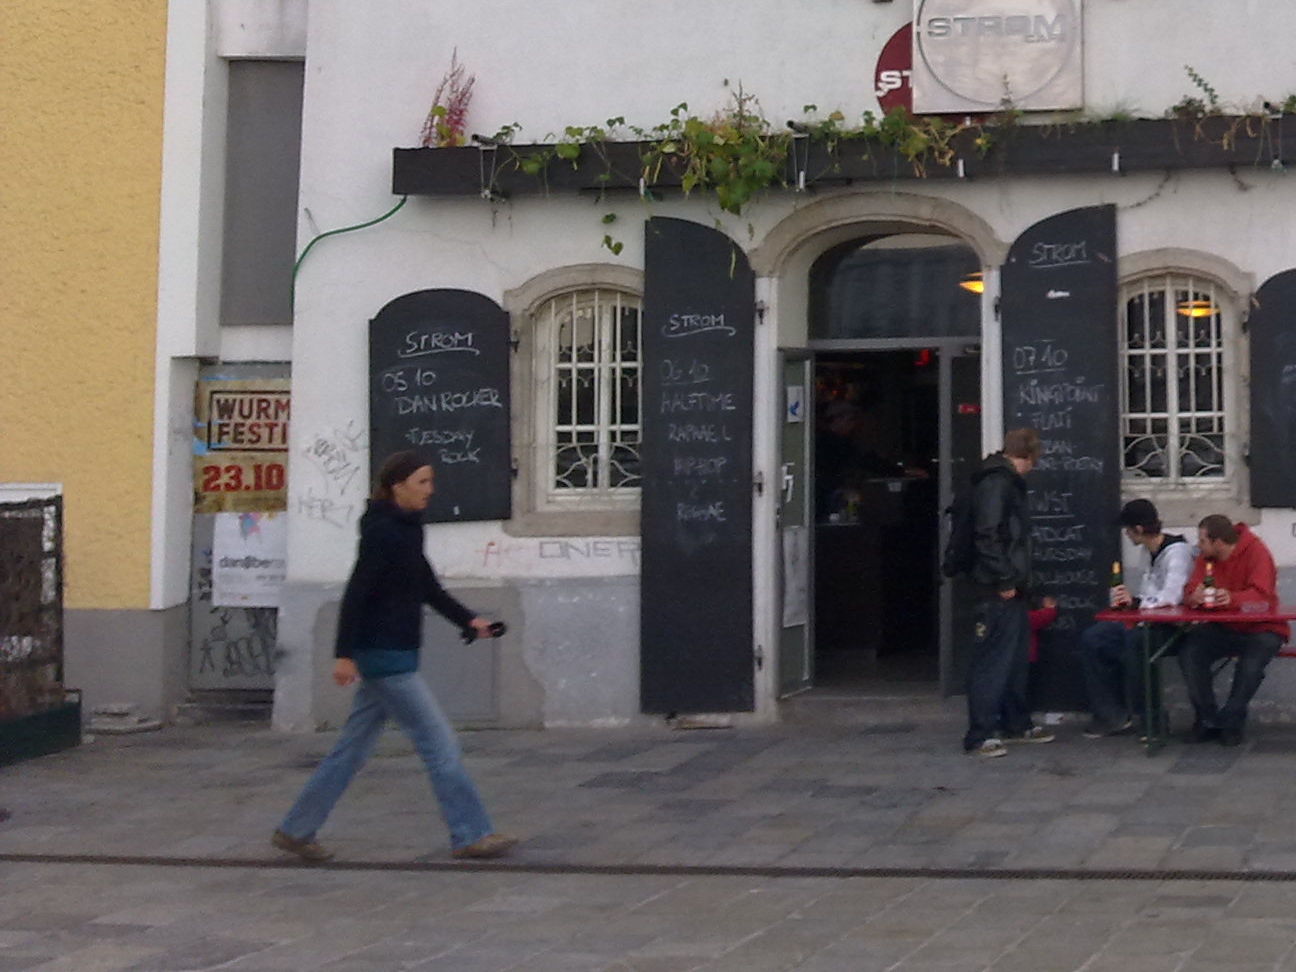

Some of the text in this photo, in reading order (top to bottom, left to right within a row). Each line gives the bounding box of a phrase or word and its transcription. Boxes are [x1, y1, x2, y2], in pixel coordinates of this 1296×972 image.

[928, 14, 1066, 37] STROM
[669, 314, 725, 332] STROM
[406, 331, 473, 353] STROM
[415, 368, 436, 386] 10
[216, 398, 290, 421] WURM
[203, 463, 285, 491] 23.10
